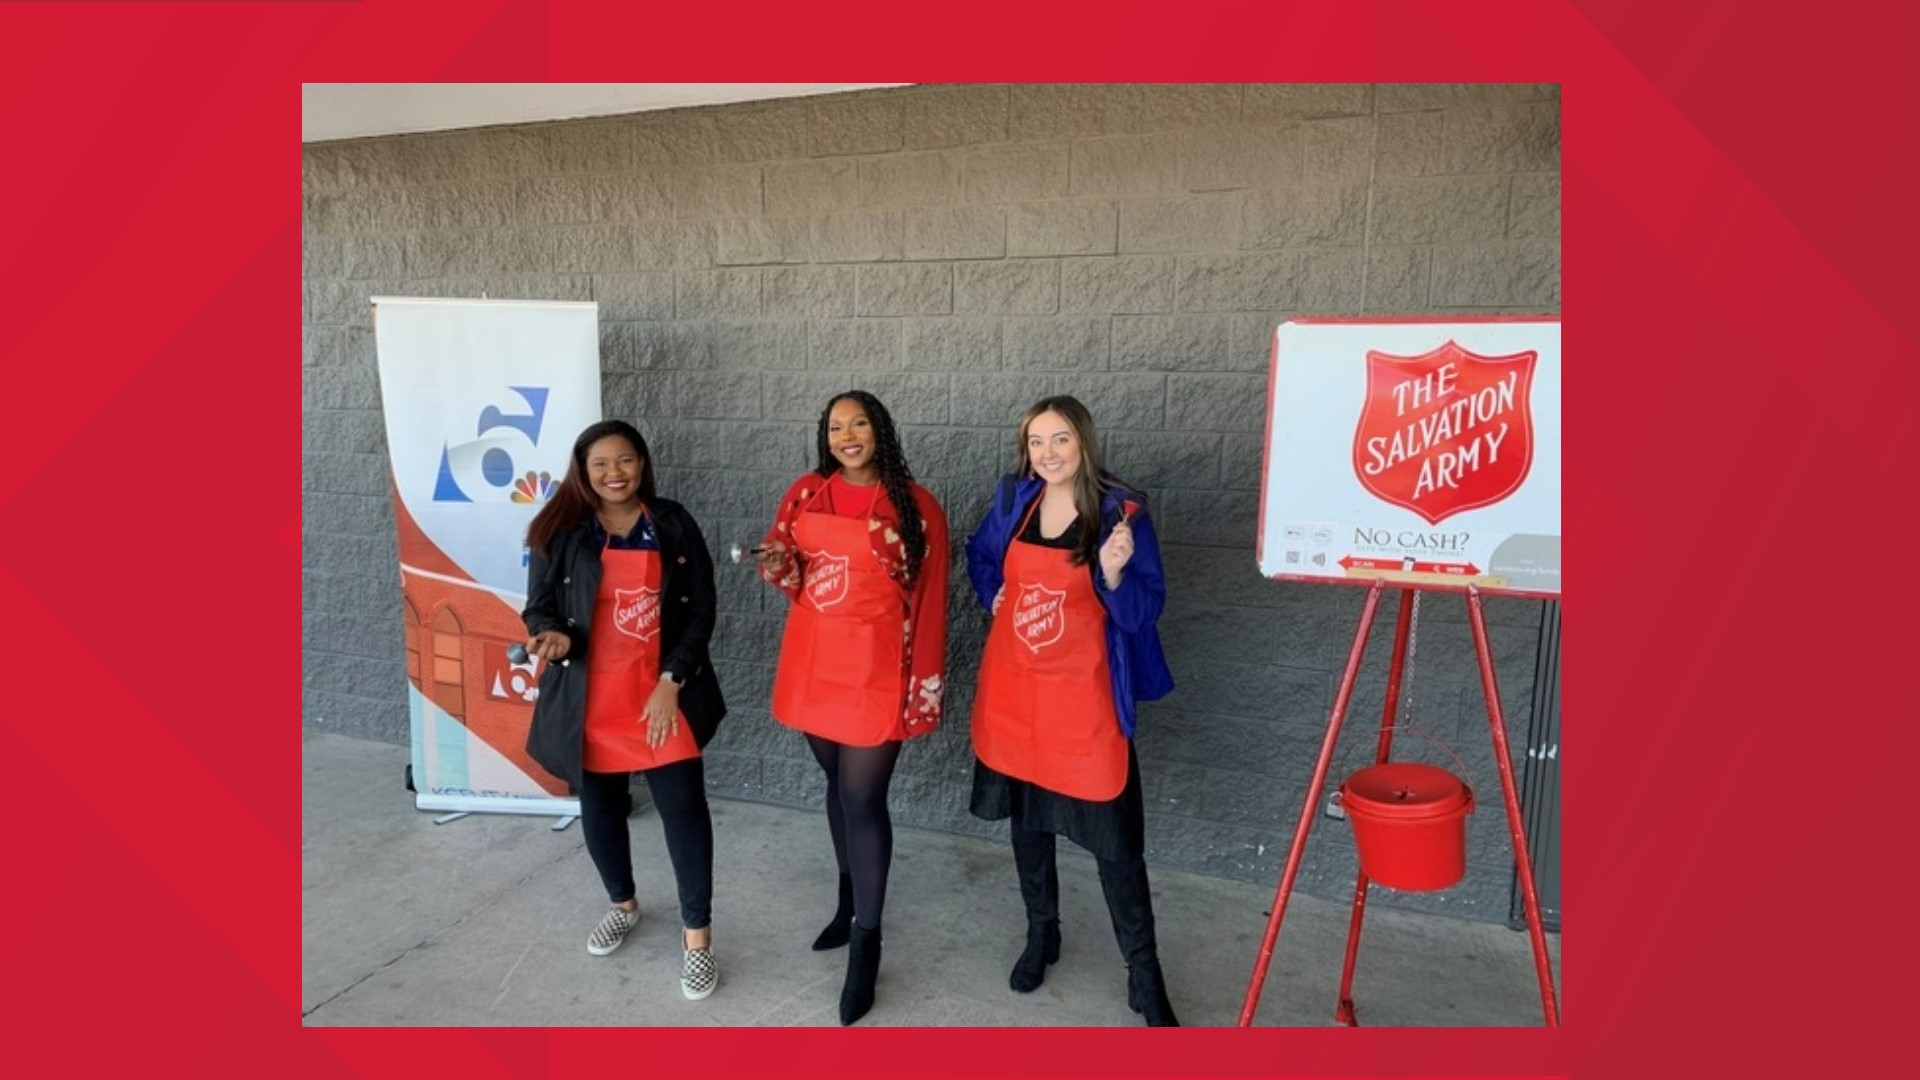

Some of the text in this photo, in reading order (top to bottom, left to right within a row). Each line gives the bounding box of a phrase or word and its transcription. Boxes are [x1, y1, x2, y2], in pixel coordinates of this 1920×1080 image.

[1392, 362, 1459, 417] THE
[1364, 370, 1517, 476] SALVATION
[1411, 422, 1508, 501] ARMY
[1397, 530, 1470, 551] CASH?
[1026, 612, 1056, 639] ARMY
